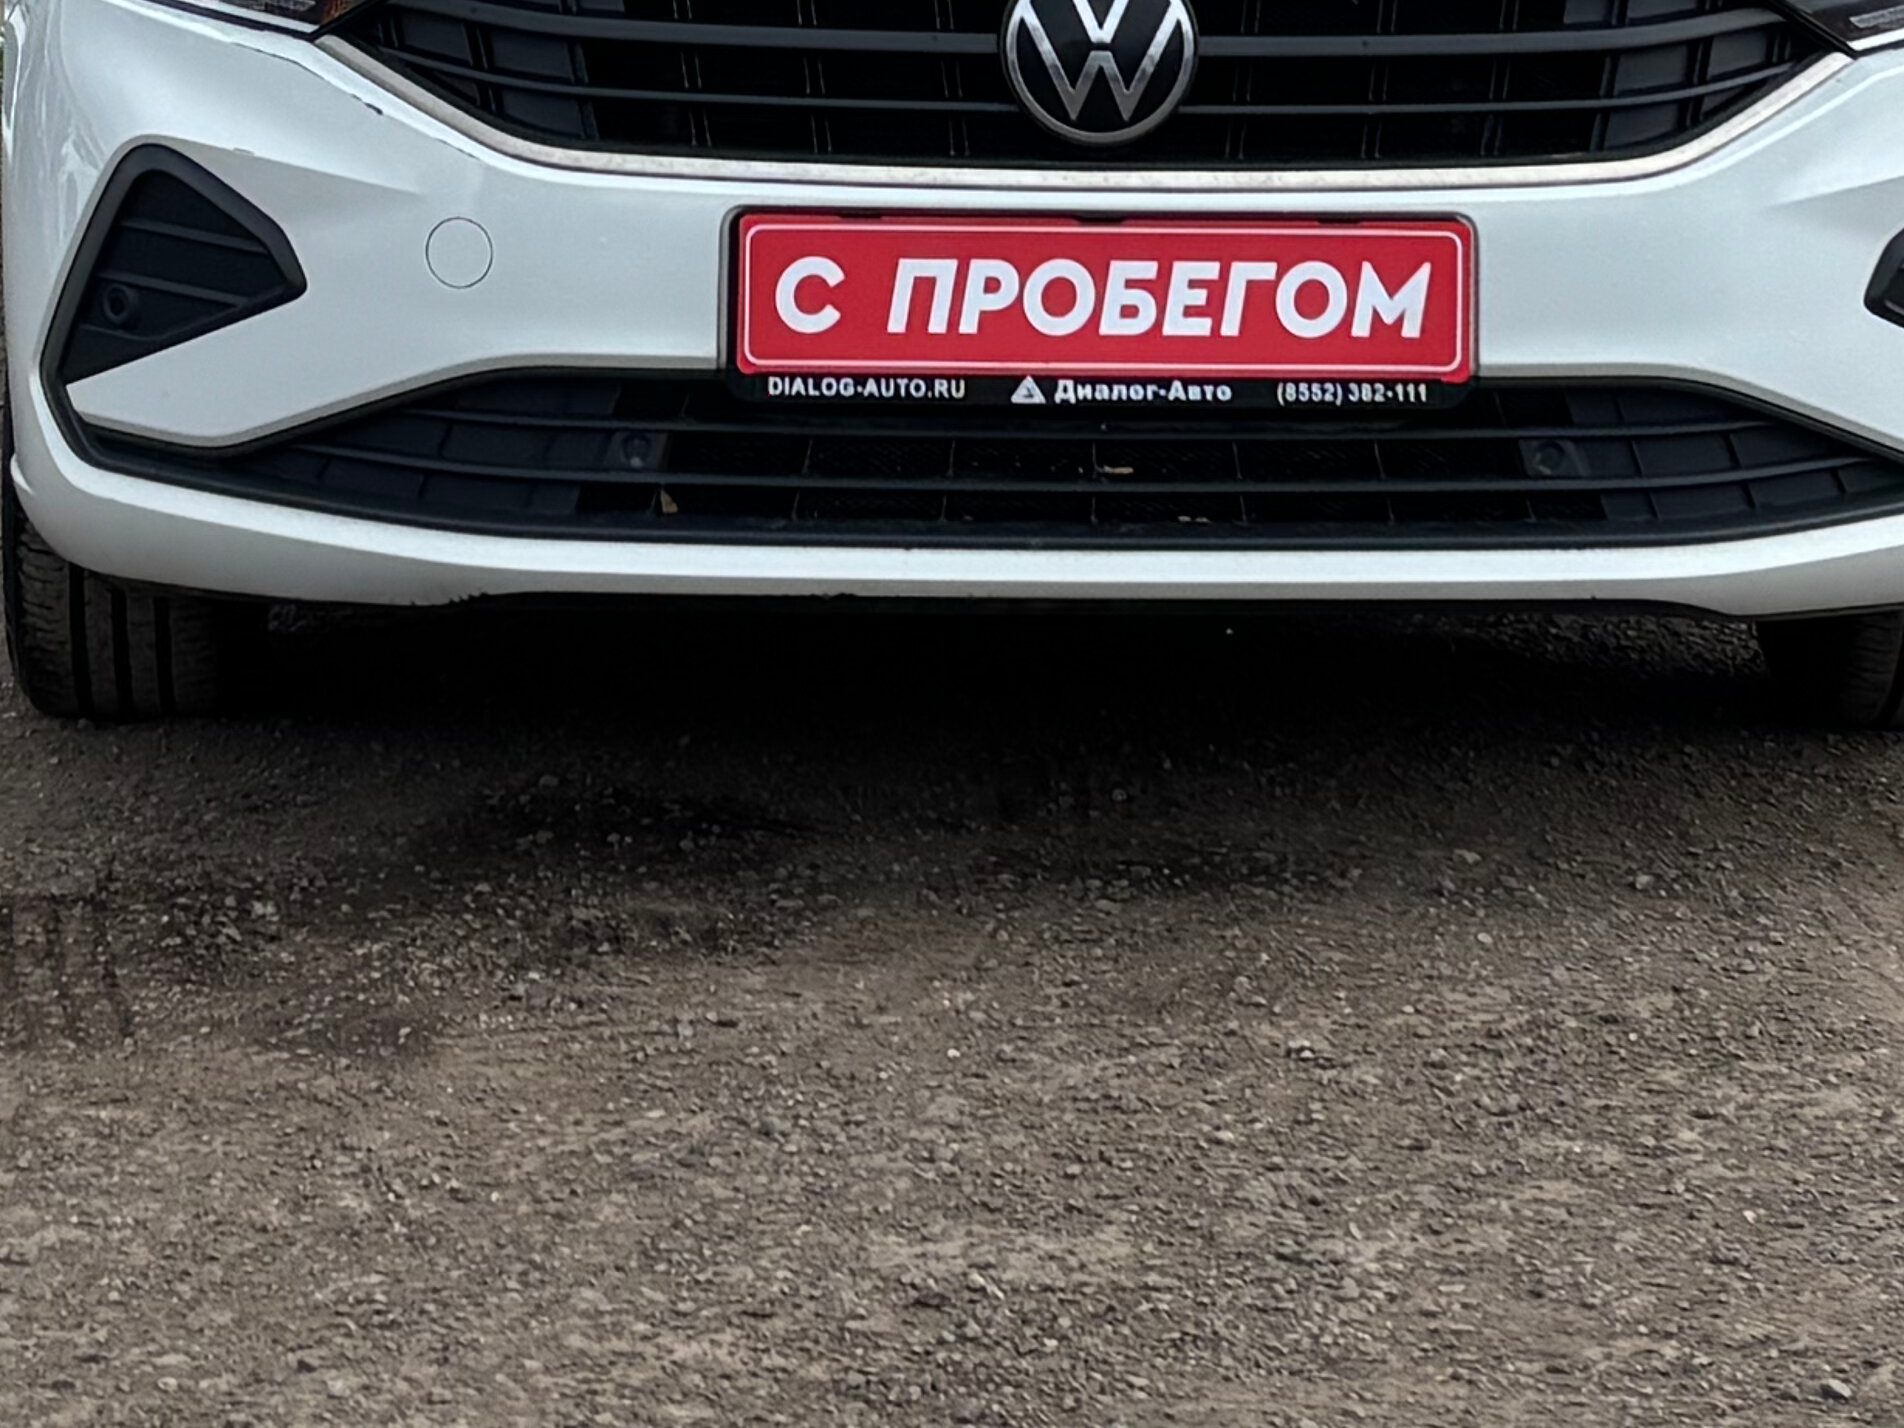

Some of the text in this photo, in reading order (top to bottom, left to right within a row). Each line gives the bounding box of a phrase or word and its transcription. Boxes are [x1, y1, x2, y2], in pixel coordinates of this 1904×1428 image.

[774, 255, 1432, 339] С ПРОБЕГОМ
[768, 376, 966, 399] DIALOG-AUTO.RU
[1054, 379, 1233, 404] Диалог-Авто
[1276, 381, 1343, 406] (8552)
